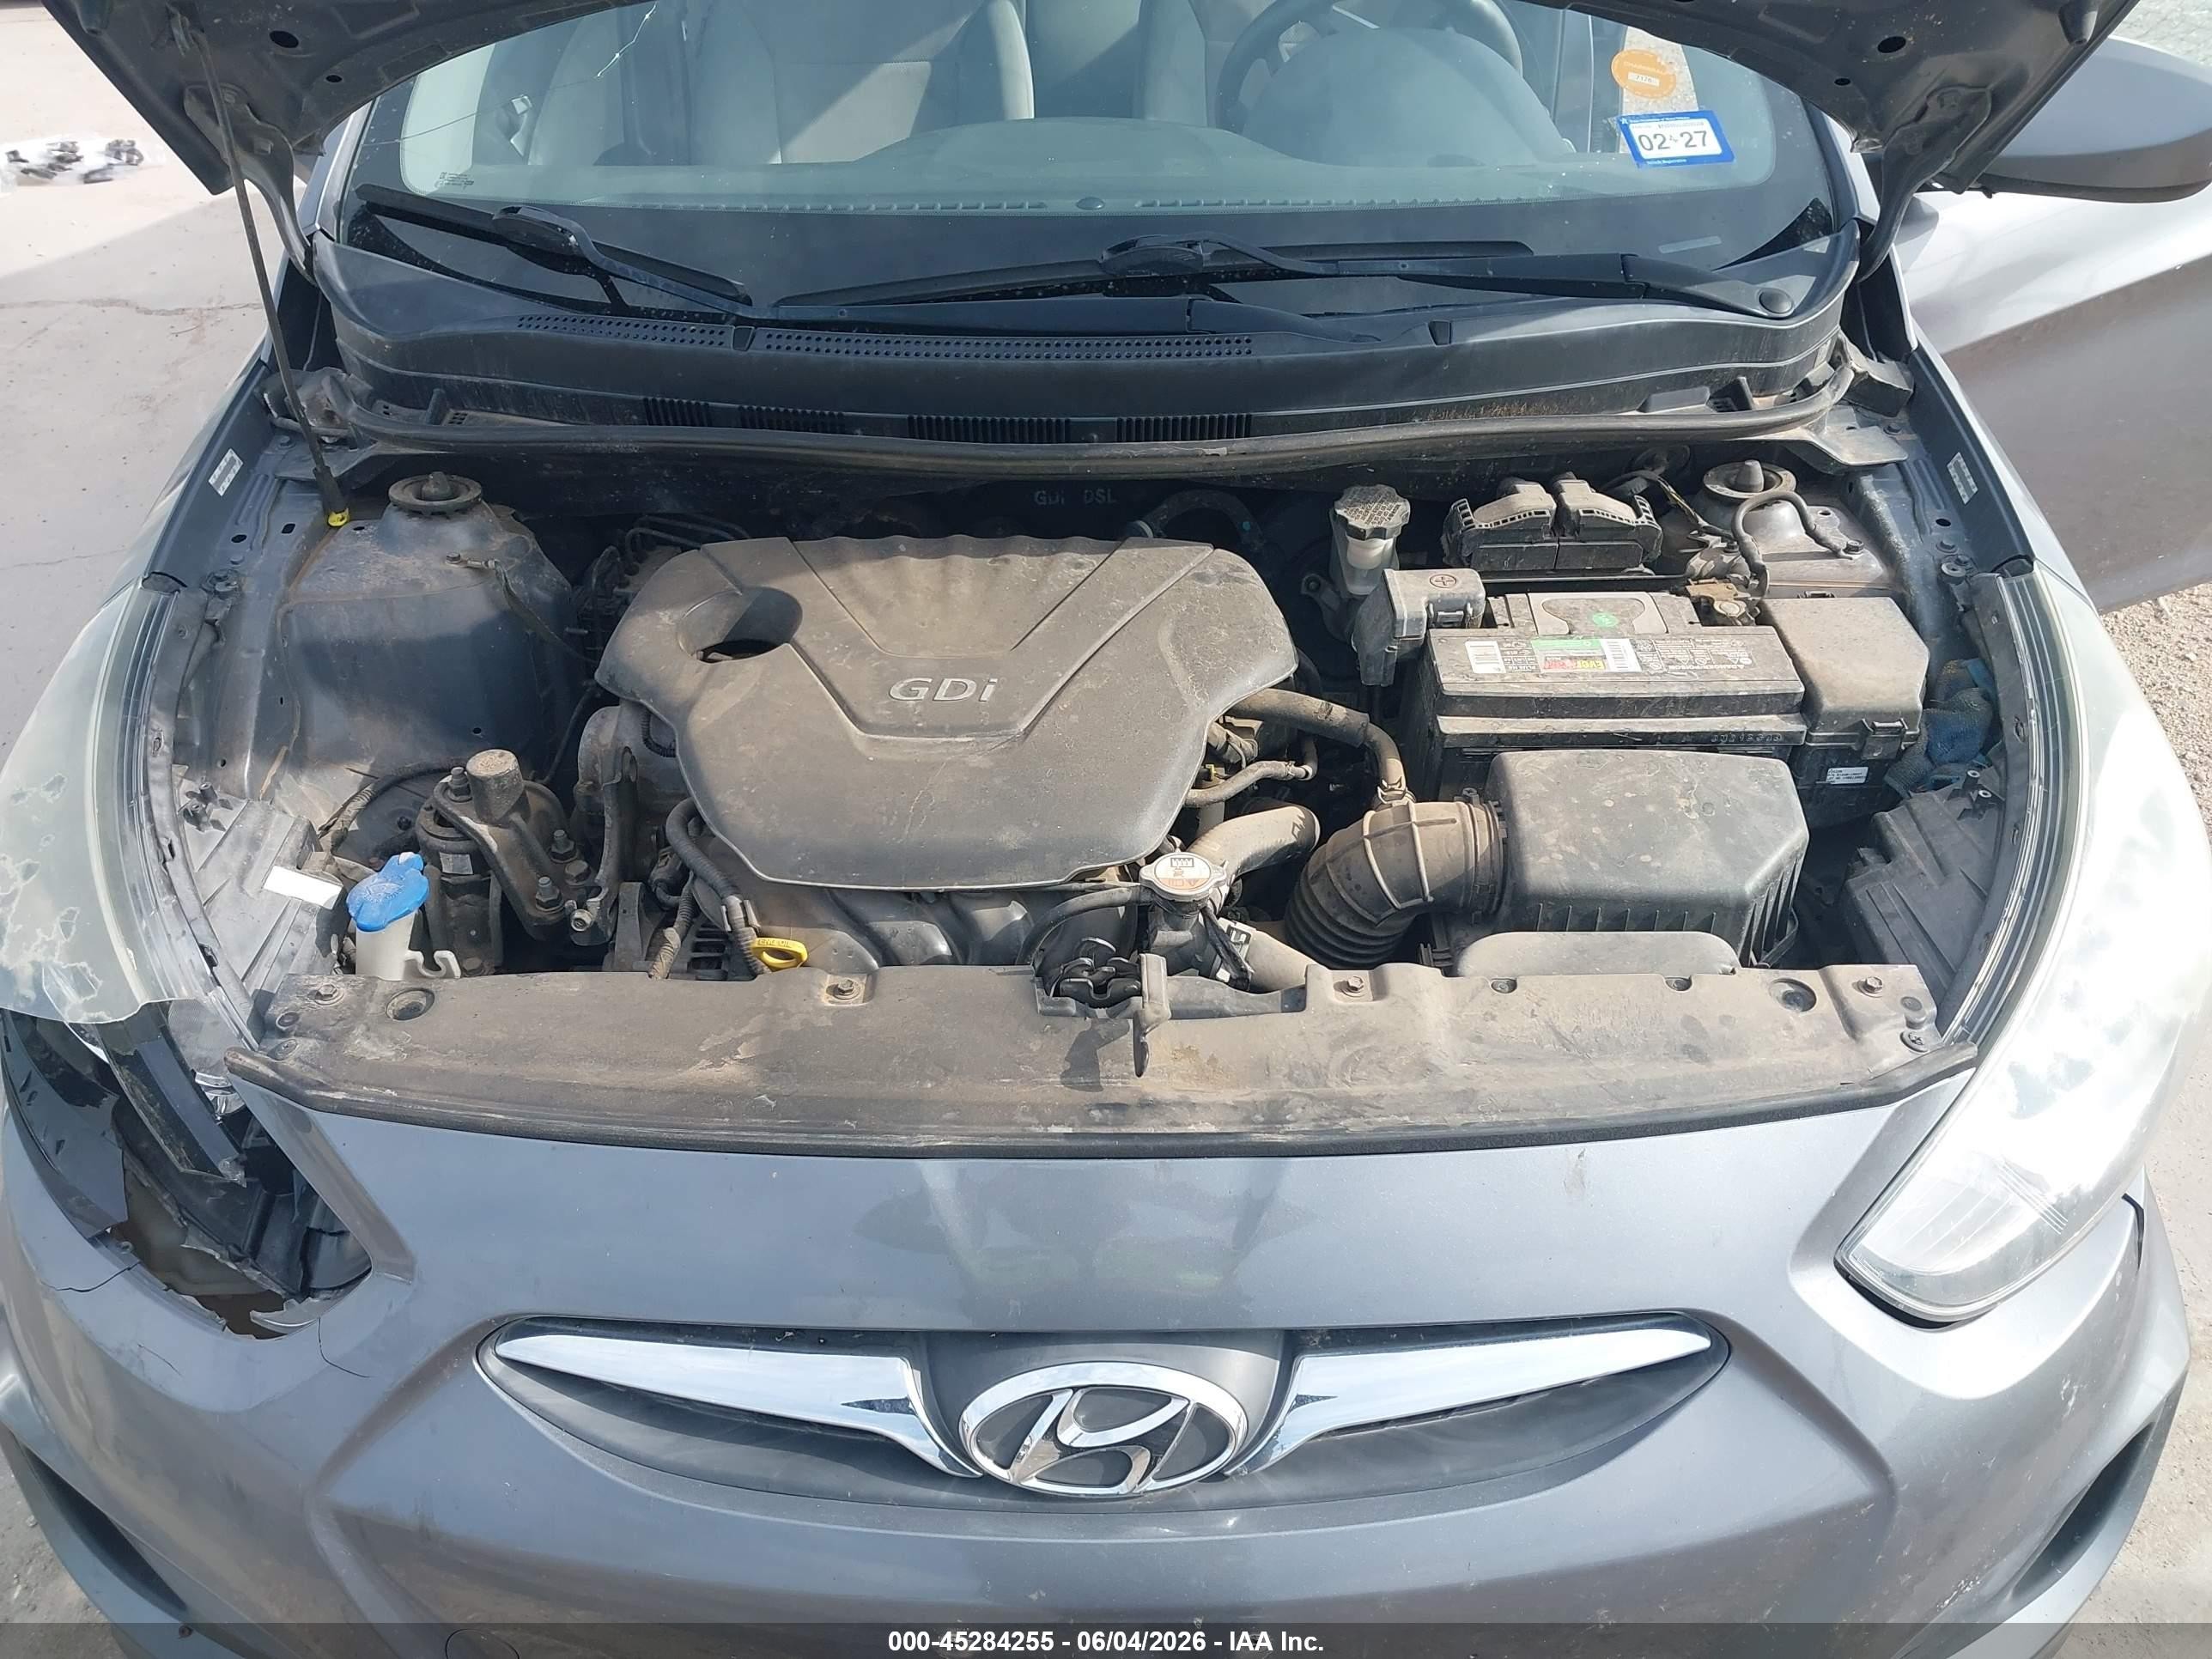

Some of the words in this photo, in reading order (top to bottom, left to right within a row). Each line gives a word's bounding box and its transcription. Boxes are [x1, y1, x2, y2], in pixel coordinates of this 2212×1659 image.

[1638, 133, 1671, 151] 02
[1680, 131, 1708, 149] 27
[889, 677, 999, 702] GDi
